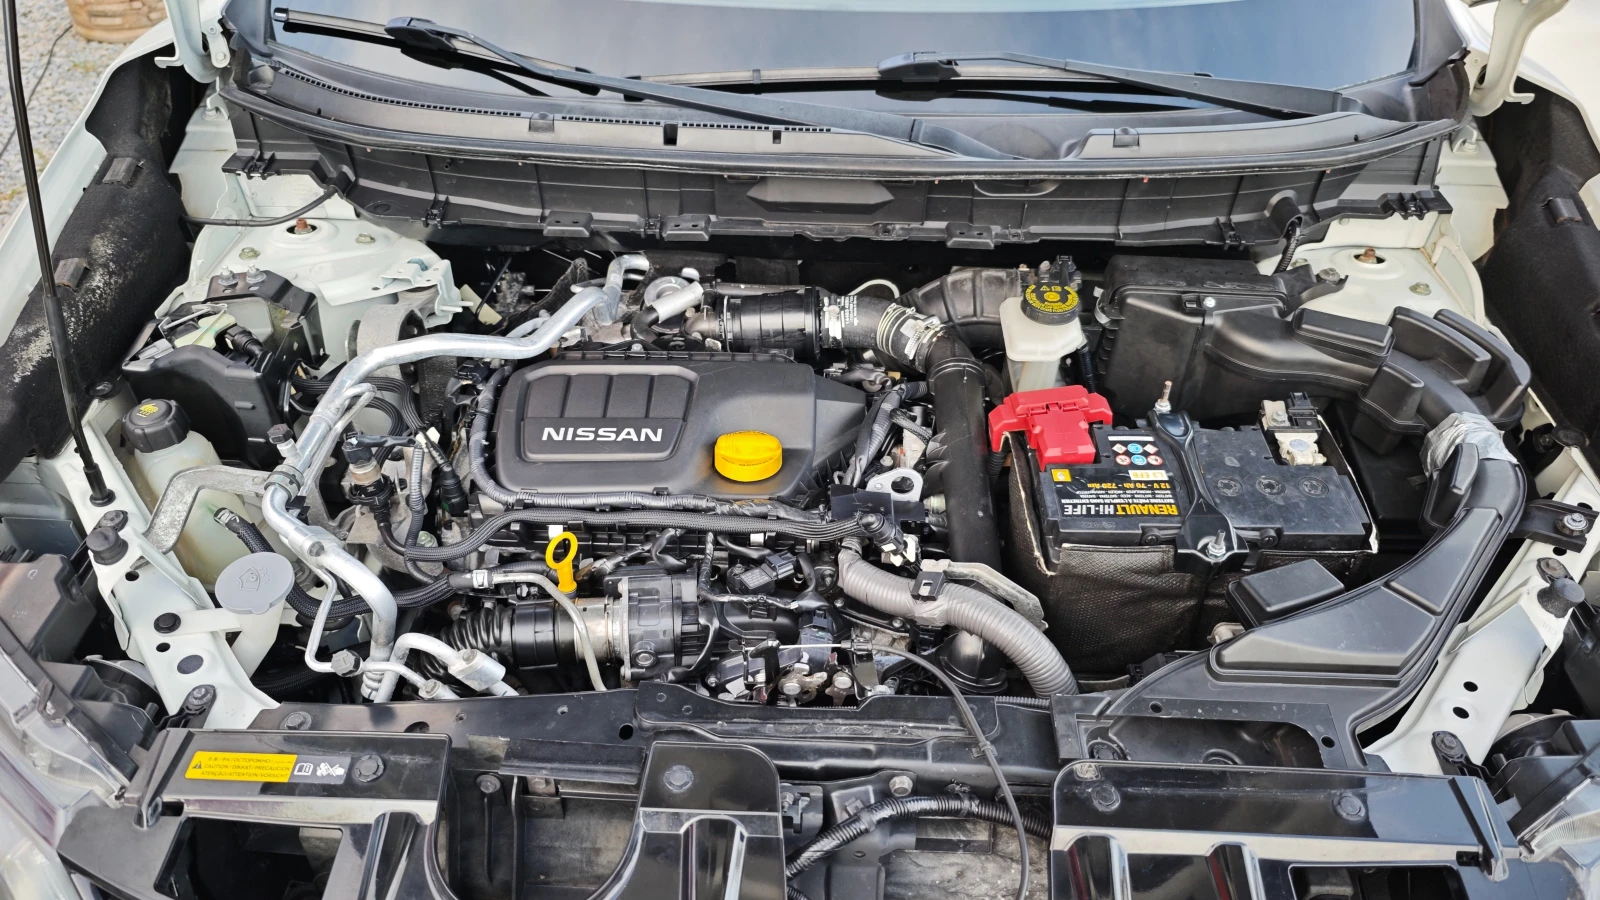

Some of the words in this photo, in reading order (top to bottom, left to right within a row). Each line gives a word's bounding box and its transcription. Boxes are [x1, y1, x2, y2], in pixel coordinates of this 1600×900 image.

[541, 427, 663, 442] NISSAN
[1063, 504, 1114, 515] Hi-LIFE
[1116, 504, 1178, 515] RENAULT
